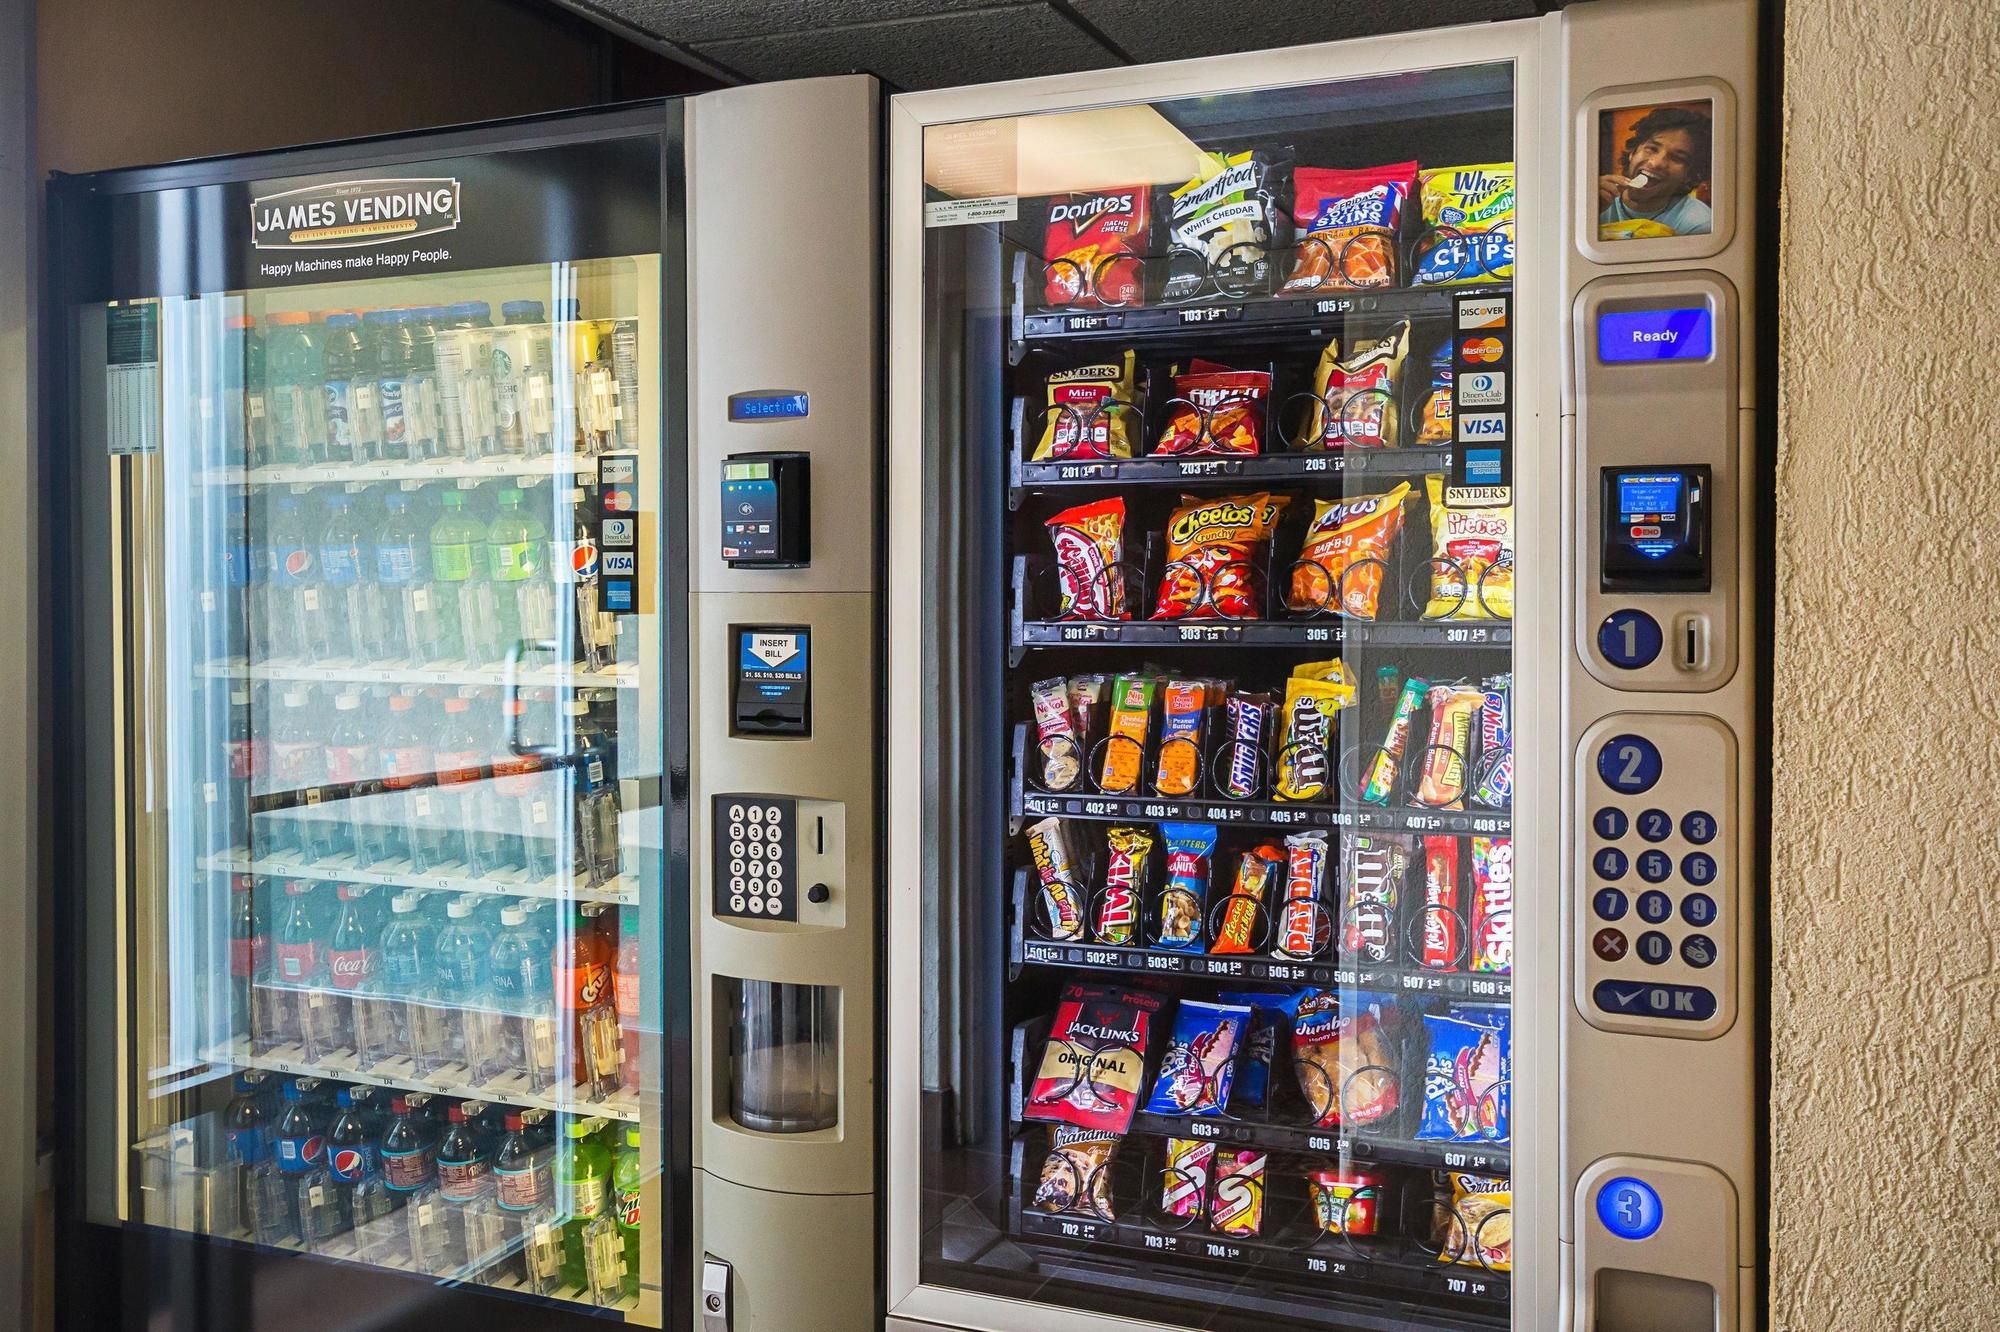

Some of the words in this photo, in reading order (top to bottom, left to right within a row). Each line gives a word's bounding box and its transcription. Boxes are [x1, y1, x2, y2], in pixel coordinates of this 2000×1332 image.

[1173, 162, 1256, 213] Smartfood
[257, 201, 336, 232] JAMES
[344, 189, 453, 223] VENDING
[1050, 194, 1132, 224] Doritos
[1183, 215, 1212, 236] WHITE
[1212, 205, 1255, 222] CHEDDAR
[1316, 210, 1382, 227] SKINS
[261, 263, 292, 276] Happy
[295, 258, 342, 272] Machines
[345, 256, 373, 268] make
[376, 251, 409, 266] Happy
[413, 249, 452, 262] People.
[1317, 301, 1336, 313] 105
[1460, 306, 1504, 317] DISCOVER
[1185, 309, 1201, 321] 103
[1070, 317, 1086, 329] 101
[1633, 329, 1678, 343] Ready
[1462, 345, 1504, 356] MasterCard
[1051, 366, 1117, 380] SNYDER'S
[1068, 388, 1097, 397] Mini
[1485, 391, 1502, 399] Club
[1464, 419, 1504, 434] VISA
[1181, 463, 1201, 475] 203
[1305, 459, 1326, 471] 205
[1062, 466, 1080, 478] 201
[1448, 487, 1507, 499] SNYDER'S
[1172, 503, 1254, 542] Cheetos
[1447, 511, 1508, 535] Pieces
[1196, 528, 1236, 542] Crunchy
[606, 557, 633, 569] VISA
[1064, 628, 1083, 640] 301
[1181, 629, 1201, 640] 303
[1306, 629, 1328, 641] 305
[1447, 629, 1468, 641] 307
[1618, 619, 1636, 657] 1
[759, 639, 788, 648] INSERT
[765, 650, 782, 658] BILL
[1128, 690, 1144, 700] Nip
[1619, 746, 1642, 784] 2
[733, 808, 740, 819] A
[1085, 802, 1105, 814] 402
[1145, 805, 1165, 816] 403
[1207, 807, 1227, 819] 404
[753, 810, 757, 820] 1
[770, 811, 776, 820] 2
[1270, 811, 1291, 823] 405
[1332, 813, 1352, 825] 406
[1406, 816, 1426, 828] 407
[1473, 819, 1495, 831] 408
[1605, 813, 1616, 834] 1
[1648, 815, 1662, 837] 2
[1692, 817, 1707, 839] 3
[733, 827, 740, 836] B
[752, 828, 758, 838] 3
[770, 829, 777, 839] 4
[733, 844, 741, 854] C
[752, 846, 759, 855] 5
[771, 847, 777, 857] 6
[734, 863, 742, 872] D
[753, 864, 759, 874] 7
[1604, 853, 1618, 874] 4
[1648, 856, 1662, 877] 5
[1692, 858, 1707, 880] 6
[771, 865, 777, 875] 8
[734, 881, 740, 890] E
[752, 882, 759, 891] 9
[771, 883, 778, 893] 0
[1101, 846, 1134, 934] TWIX
[735, 899, 740, 908] F
[1487, 844, 1512, 965] Skittles
[1606, 894, 1618, 915] 7
[1648, 896, 1662, 918] 8
[1692, 898, 1707, 920] 9
[1648, 936, 1662, 958] 0
[1087, 951, 1106, 963] 502
[1148, 957, 1168, 969] 503
[1208, 961, 1228, 974] 504
[1269, 967, 1289, 979] 505
[1334, 971, 1355, 983] 506
[1403, 977, 1424, 989] 507
[1066, 986, 1084, 998] 70
[1472, 981, 1495, 994] 508
[1121, 994, 1160, 1008] Protein
[1650, 988, 1695, 1012] OK
[1066, 1022, 1097, 1038] JACK
[1296, 1015, 1351, 1036] Jumbo
[383, 1078, 393, 1086] D4
[617, 1111, 628, 1119] D8
[1191, 1124, 1212, 1136] 603
[1309, 1137, 1330, 1150] 605
[1445, 1153, 1466, 1166] 607
[1214, 1206, 1236, 1224] STRIDE
[1618, 1189, 1642, 1229] 3
[1062, 1223, 1079, 1236] 702
[1144, 1235, 1163, 1248] 703
[1207, 1244, 1226, 1258] 704
[1307, 1258, 1327, 1272] 705
[1447, 1279, 1467, 1293] 707
